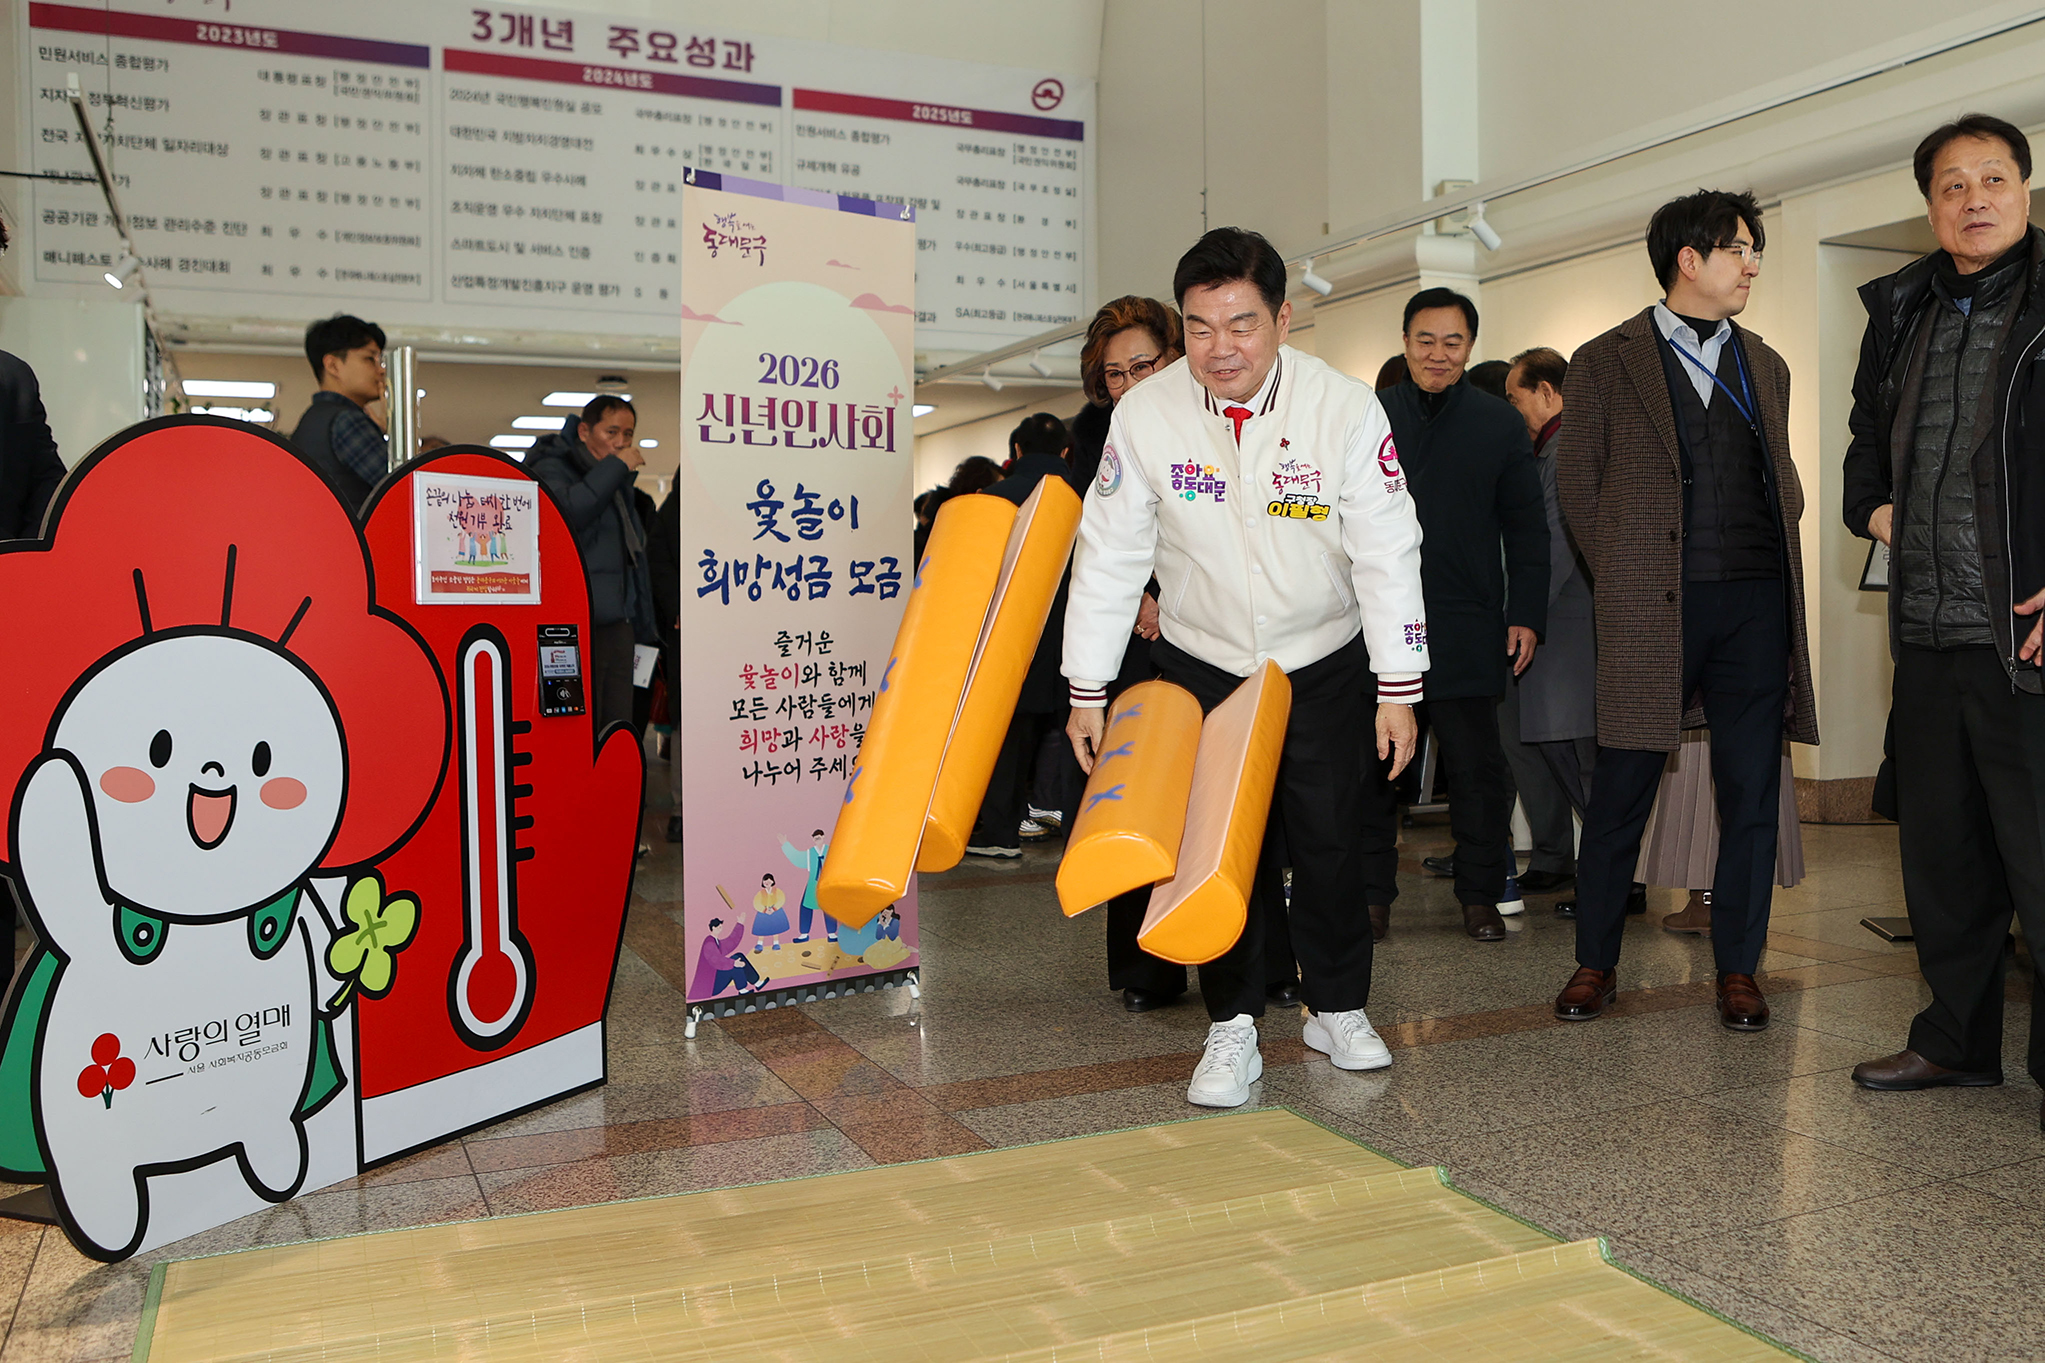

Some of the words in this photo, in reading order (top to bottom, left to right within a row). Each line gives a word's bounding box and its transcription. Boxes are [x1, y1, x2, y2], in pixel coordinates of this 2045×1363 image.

[196, 23, 279, 48] 2023년도
[471, 9, 574, 53] 3개년
[607, 24, 755, 73] 주요성과
[38, 46, 108, 66] 민원서비스
[114, 53, 169, 73] 종합평가
[582, 66, 654, 89] 2024년도
[912, 104, 973, 125] 2025년도
[41, 128, 69, 146] 전국
[41, 208, 98, 227] 공공기관
[43, 250, 113, 267] 매니페스토
[702, 222, 767, 267] 동대문구
[757, 352, 840, 391] 2026
[696, 393, 897, 453] 신년인사회
[1272, 470, 1322, 495] 동대문구
[471, 512, 487, 530] 기부
[746, 478, 858, 542] 윷놀이
[1268, 501, 1330, 521] 이필형
[697, 548, 833, 605] 희망성금
[848, 556, 902, 601] 모금
[774, 630, 834, 658] 즐거운
[739, 662, 822, 690] 윷놀이와
[828, 660, 867, 687] 함께
[729, 696, 769, 721] 모든
[775, 690, 875, 721] 사람들에게
[739, 726, 803, 754] 희망과
[808, 722, 866, 751] 사랑을
[742, 757, 801, 787] 나누어
[143, 1019, 228, 1062] 사랑의
[235, 1004, 290, 1047] 열매
[208, 1041, 288, 1069] 사회복지공동모금회
